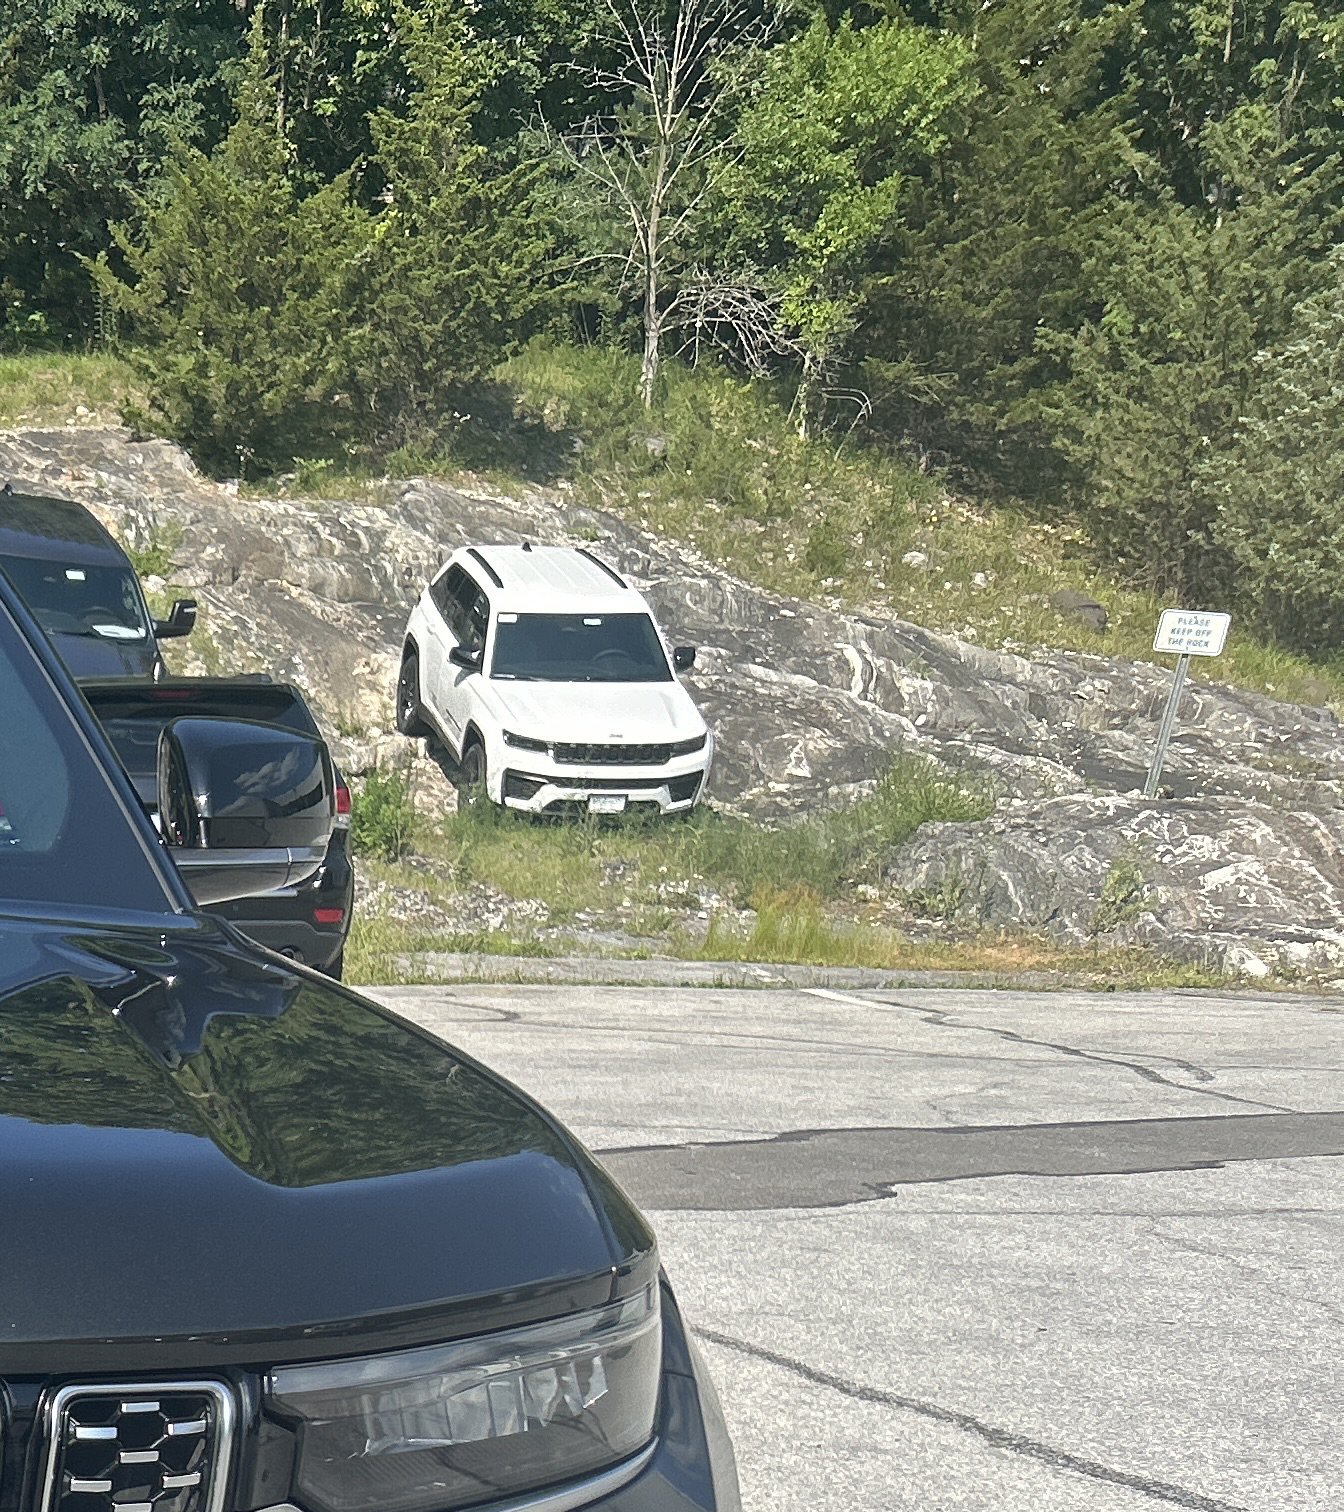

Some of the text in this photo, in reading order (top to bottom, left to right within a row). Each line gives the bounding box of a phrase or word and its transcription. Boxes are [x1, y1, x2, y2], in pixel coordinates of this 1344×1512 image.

[1178, 617, 1211, 627] PLEASE
[1170, 627, 1213, 637] KEEP OFF
[1168, 637, 1209, 648] THE ROCK
